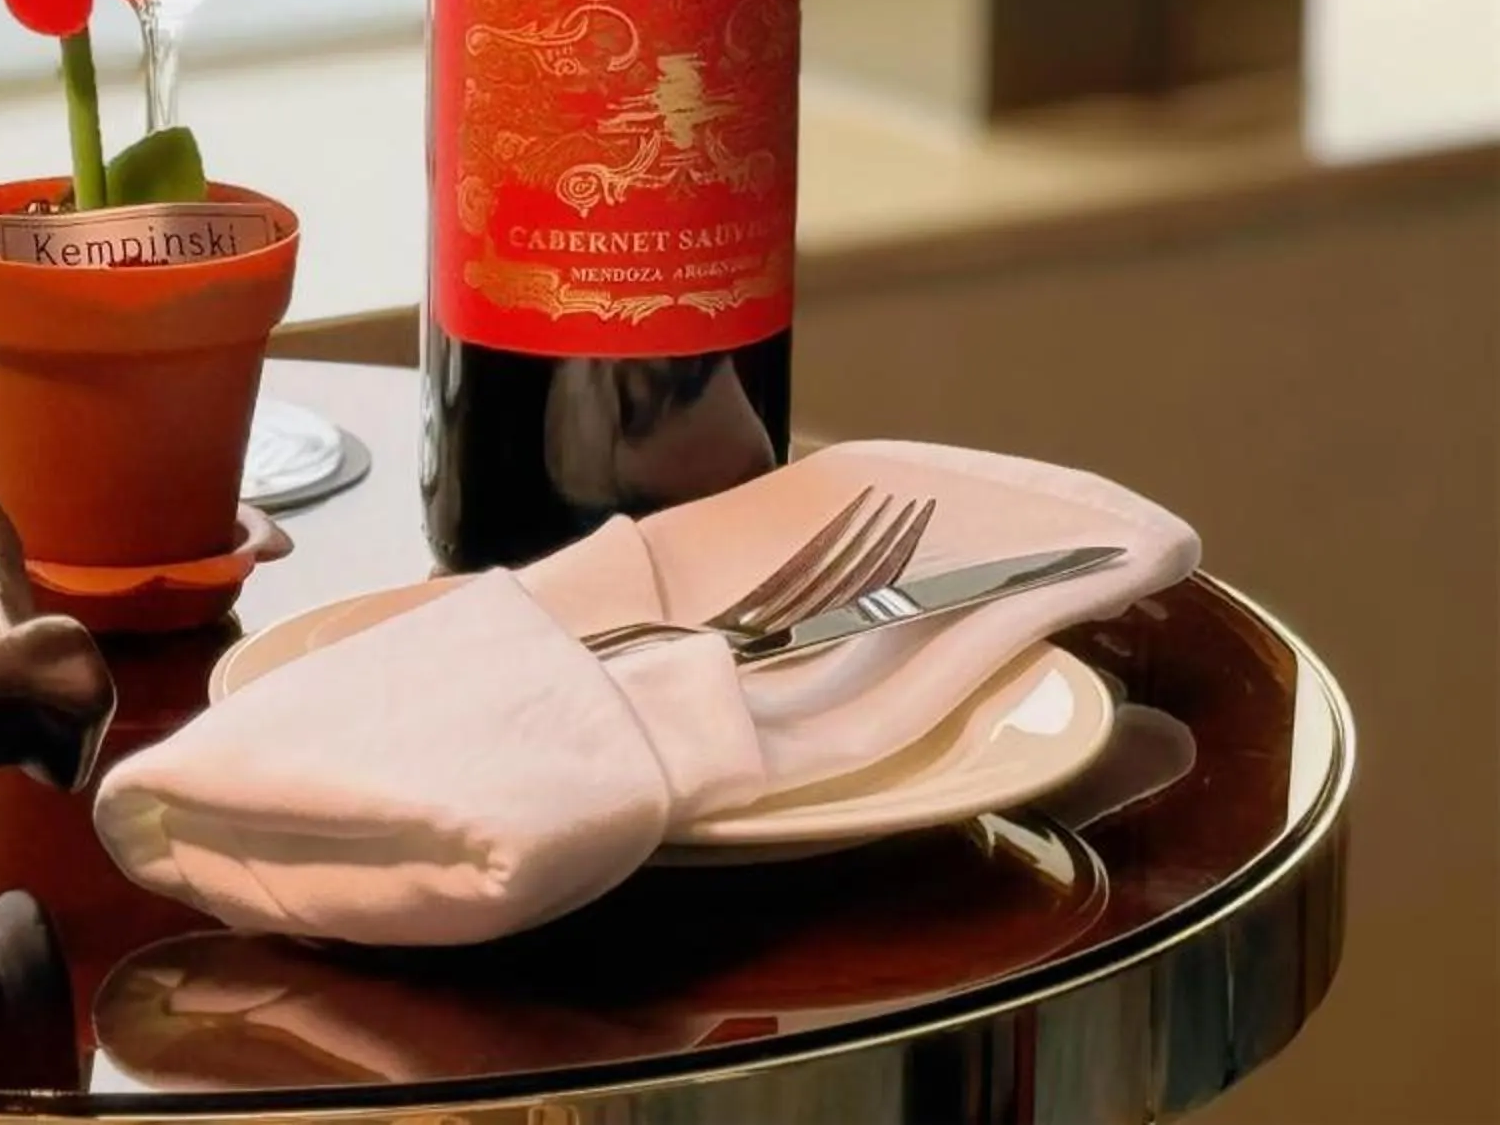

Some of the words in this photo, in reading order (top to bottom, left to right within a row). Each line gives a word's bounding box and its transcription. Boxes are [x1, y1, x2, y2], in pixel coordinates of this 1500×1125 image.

[32, 221, 239, 267] Kempinski
[509, 226, 672, 254] CABERNET
[571, 265, 664, 283] MENDOZA
